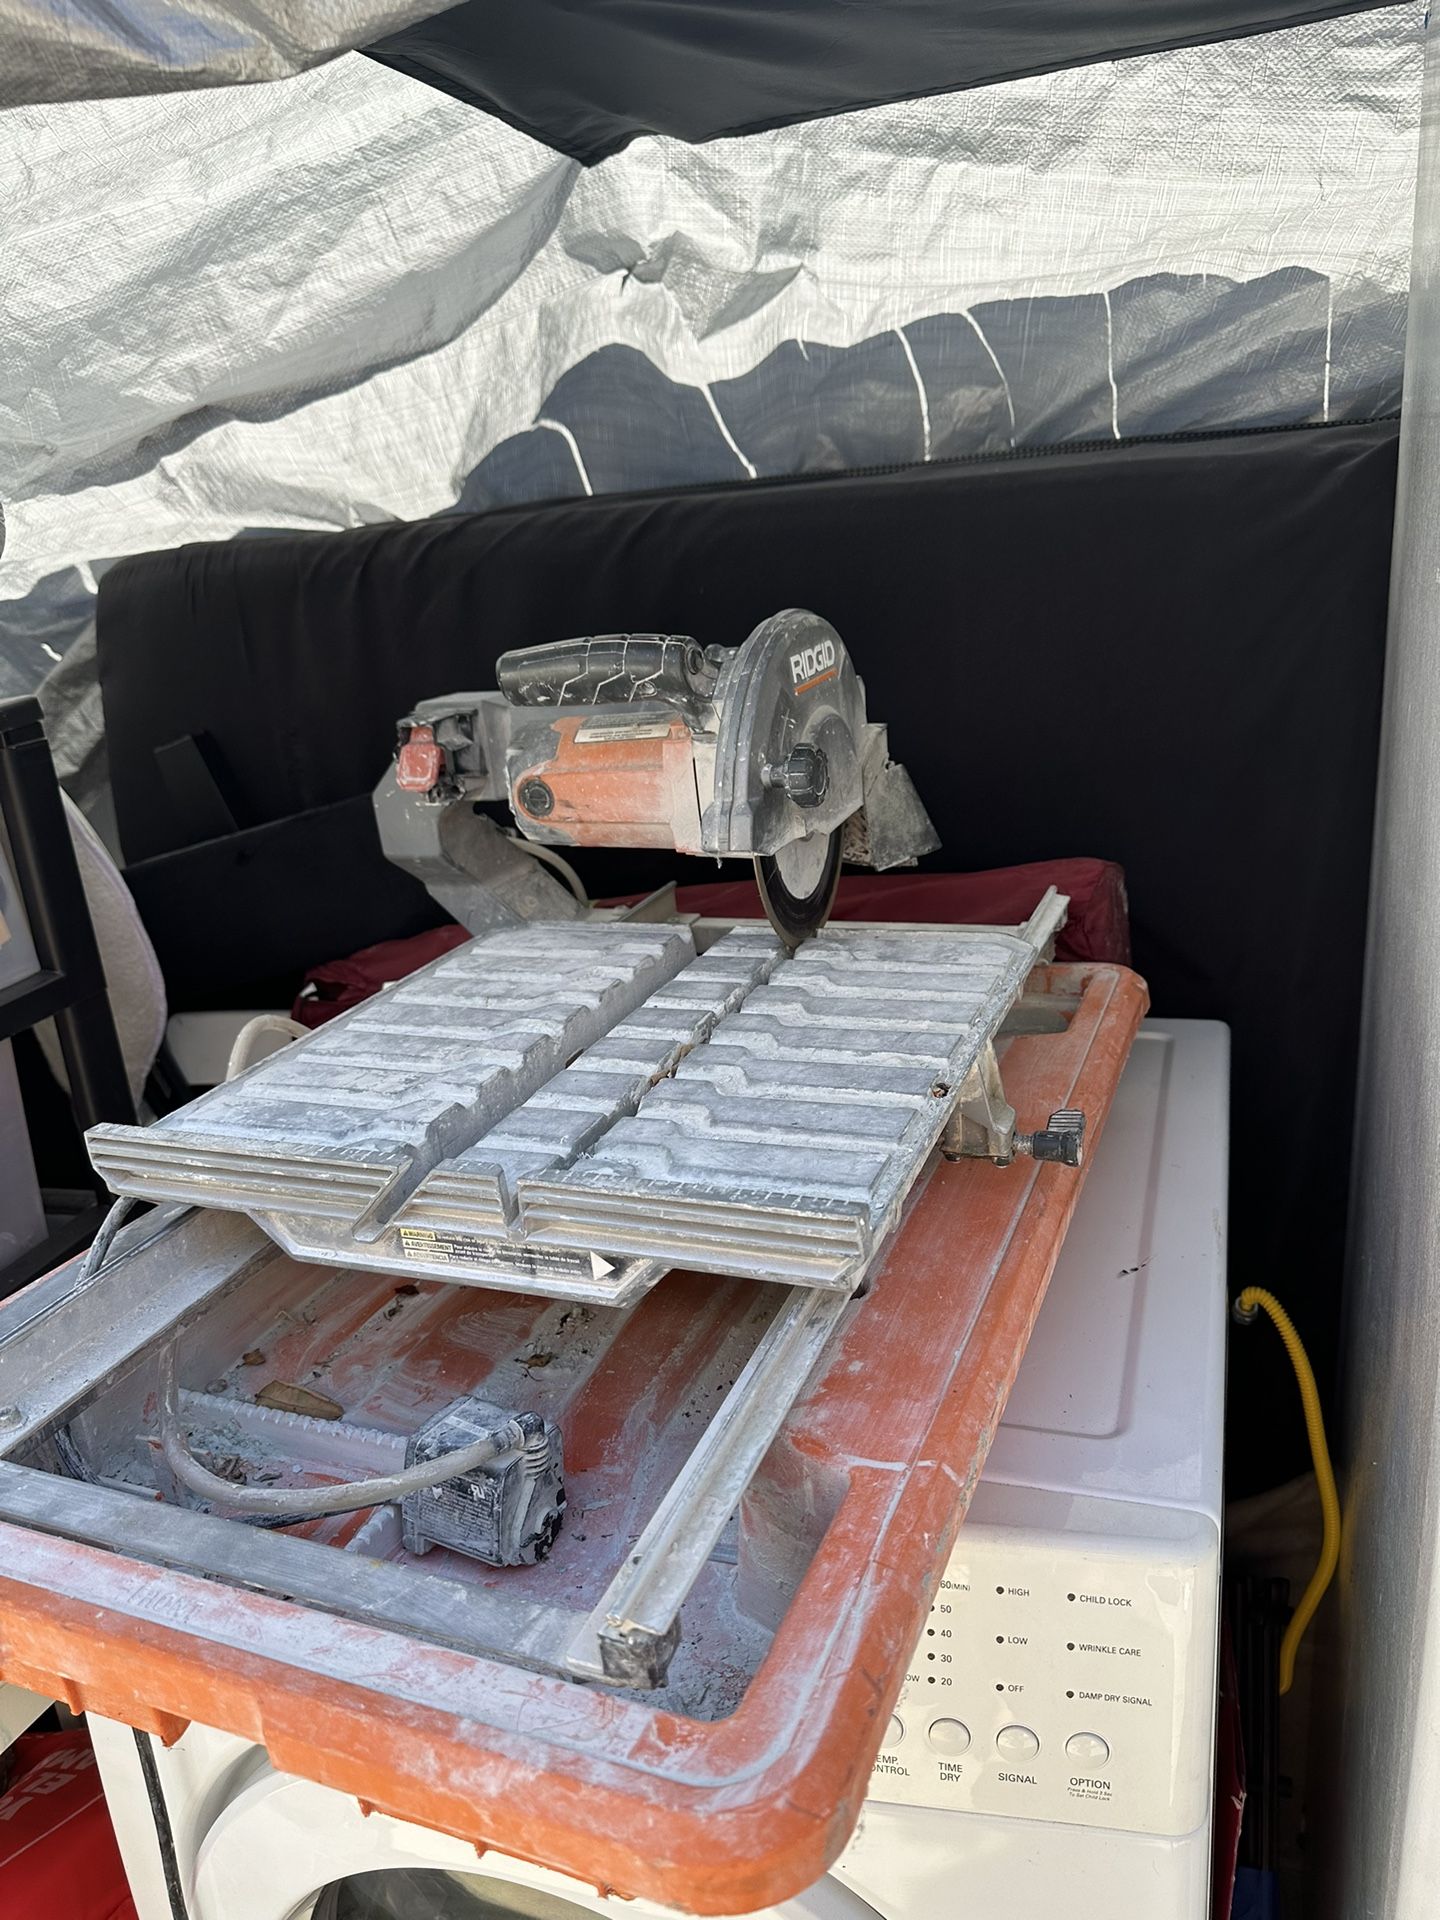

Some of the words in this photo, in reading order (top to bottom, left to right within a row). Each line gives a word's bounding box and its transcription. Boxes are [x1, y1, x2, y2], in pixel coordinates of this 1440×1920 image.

[790, 640, 835, 684] RIDGID
[1008, 1588, 1030, 1597] HIGH
[1079, 1594, 1106, 1605] CHILD
[1108, 1597, 1132, 1607] LOCK
[940, 1604, 952, 1614] 50
[940, 1629, 952, 1638] 40
[1008, 1636, 1028, 1645] LOW
[1079, 1643, 1117, 1655] WRINKLE
[1118, 1647, 1142, 1657] CARE
[940, 1654, 952, 1663] 30
[904, 1673, 920, 1682] OW
[941, 1677, 952, 1686] 20
[1007, 1684, 1024, 1693] OFF
[1079, 1691, 1103, 1700] DAMP
[1104, 1693, 1121, 1703] DRY
[1122, 1695, 1153, 1706] SIGNAL
[875, 1754, 899, 1765] EMP.
[938, 1761, 963, 1773] TIME
[939, 1772, 961, 1783] DRY
[998, 1772, 1038, 1785] SIGNAL
[1069, 1777, 1111, 1790] OPTION
